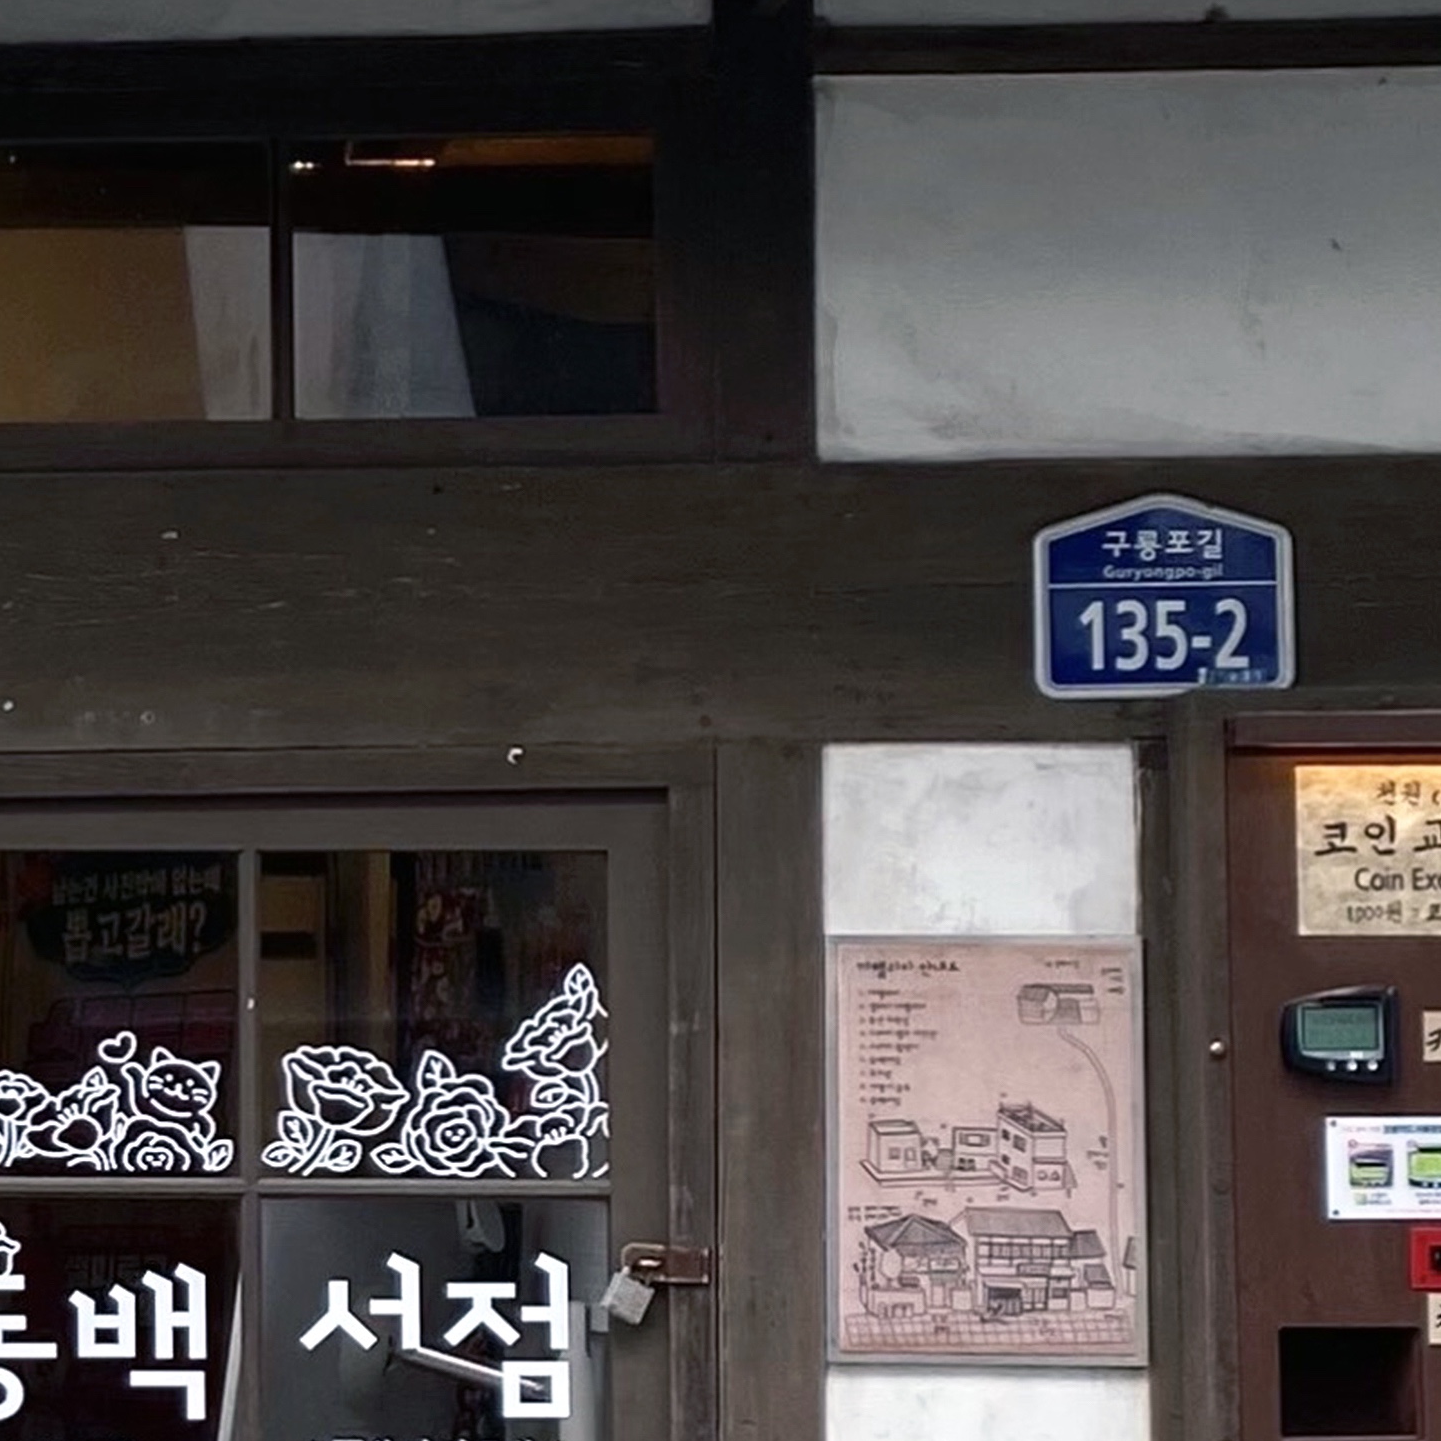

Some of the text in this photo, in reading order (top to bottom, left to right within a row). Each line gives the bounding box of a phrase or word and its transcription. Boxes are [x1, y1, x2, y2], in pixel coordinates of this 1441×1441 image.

[1101, 528, 1224, 562] 구룡포길
[1102, 562, 1224, 581] Guryongpo-gil
[1077, 597, 1251, 672] 135-2
[1314, 814, 1397, 856] 코인
[1354, 867, 1404, 891] Coin
[299, 1251, 571, 1420] 서점
